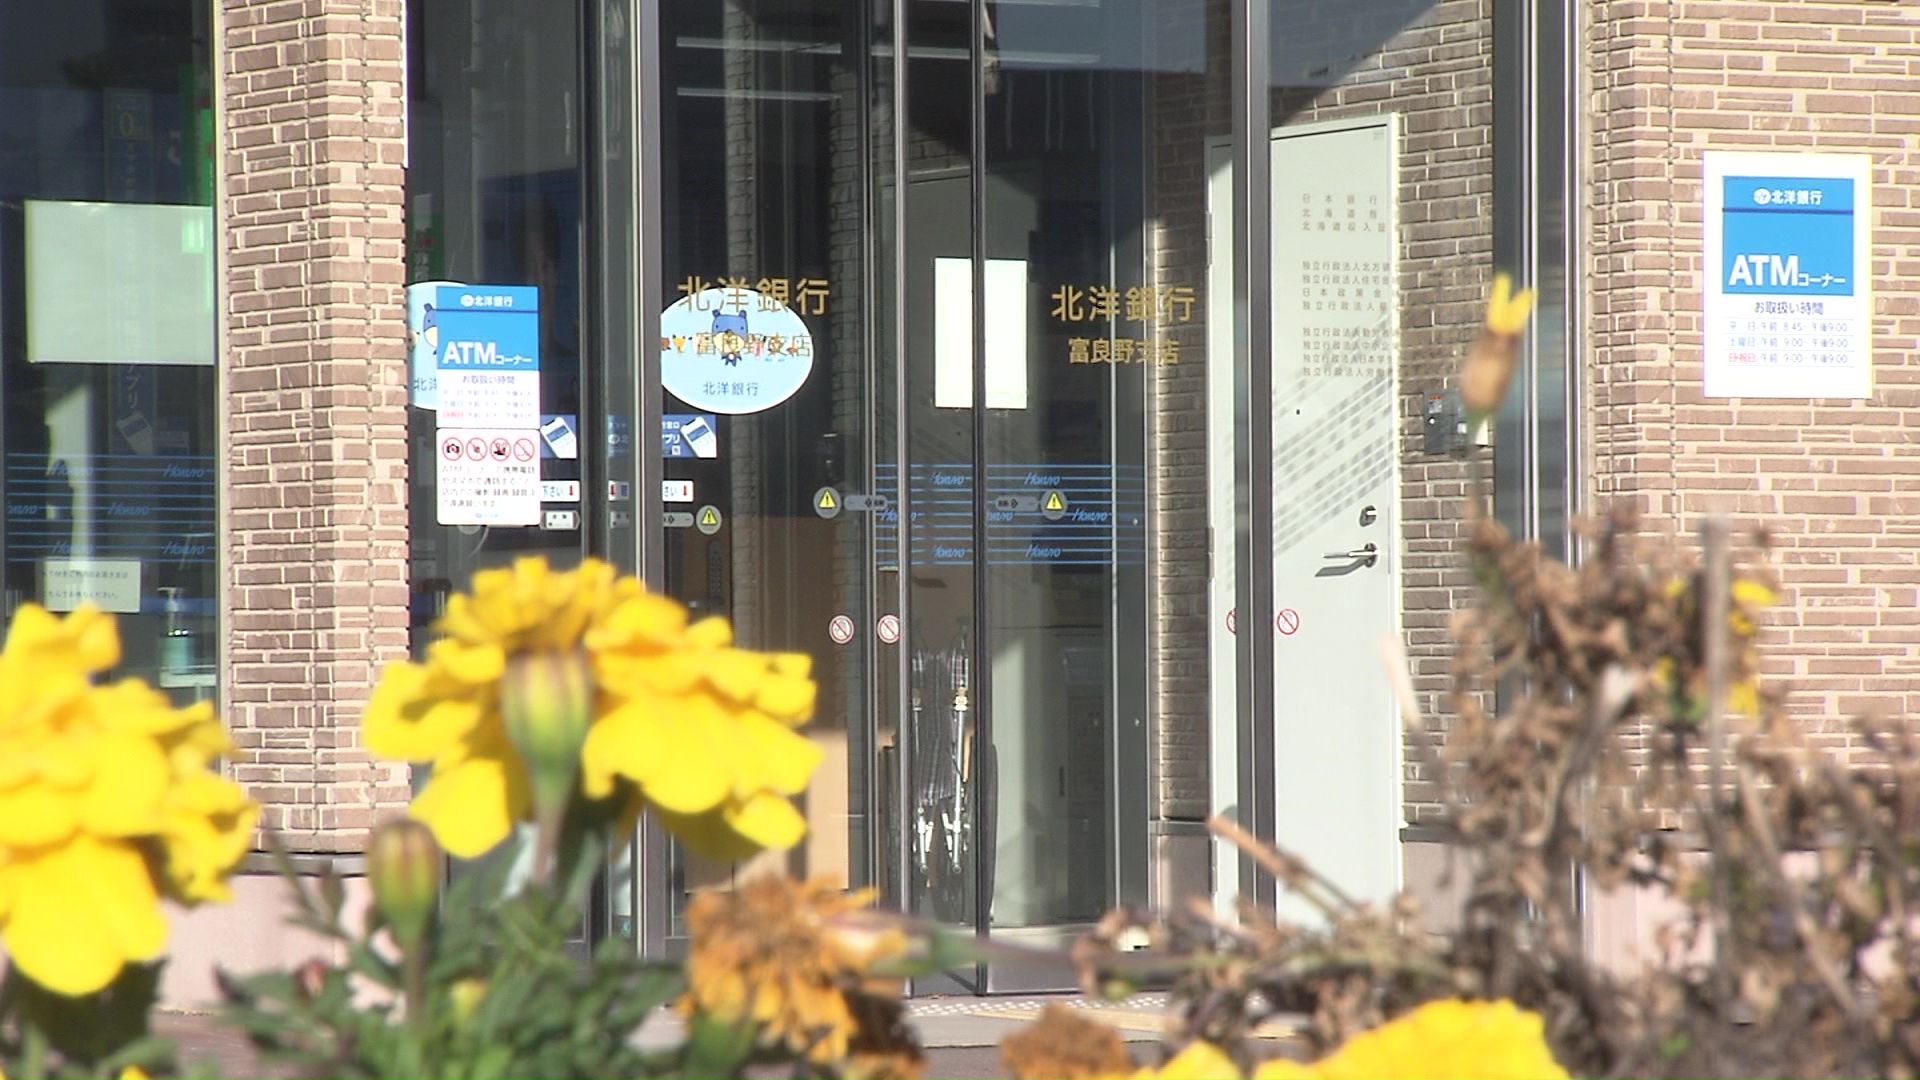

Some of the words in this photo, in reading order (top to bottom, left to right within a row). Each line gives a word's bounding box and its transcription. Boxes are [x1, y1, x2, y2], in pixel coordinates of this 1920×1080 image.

[1771, 188, 1823, 205] 北洋銀行
[474, 295, 513, 307] 北洋銀行
[677, 275, 830, 315] 北洋銀行
[1051, 284, 1195, 322] 北洋銀行
[1754, 301, 1824, 316] お取扱い時間
[696, 332, 811, 357] 富良野支店
[1068, 337, 1180, 364] 富良野支店
[703, 382, 759, 397] 北洋銀行
